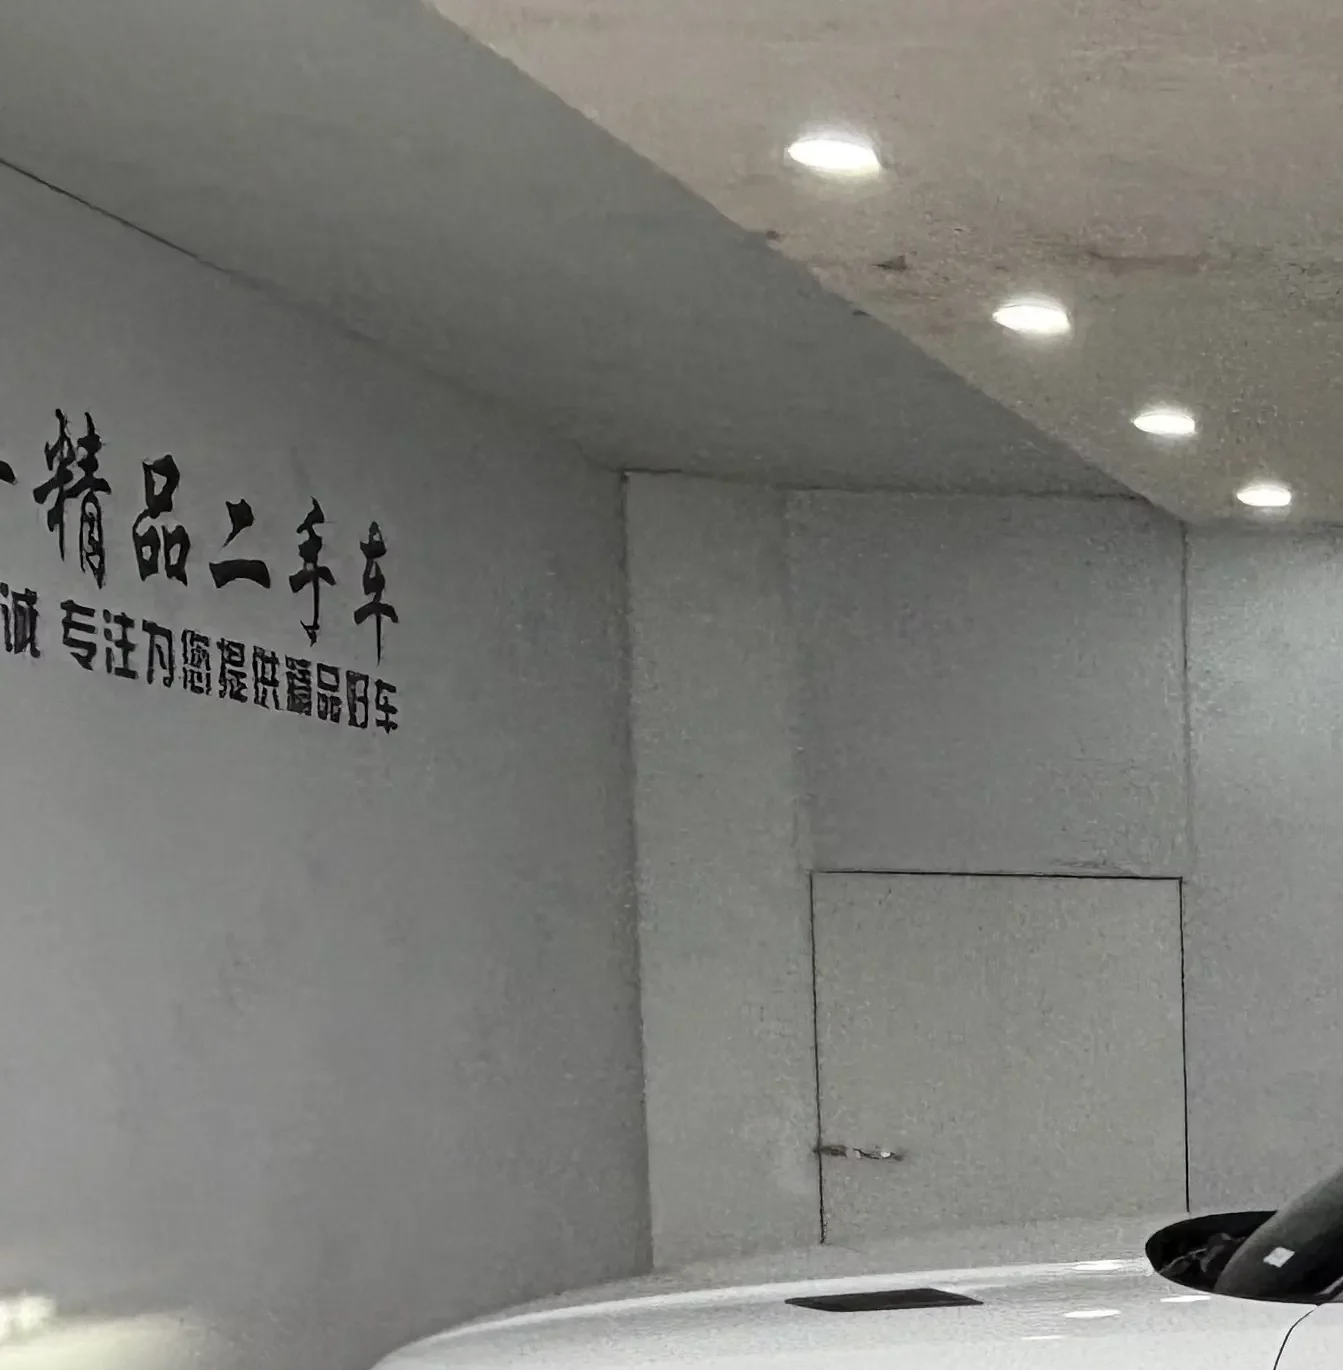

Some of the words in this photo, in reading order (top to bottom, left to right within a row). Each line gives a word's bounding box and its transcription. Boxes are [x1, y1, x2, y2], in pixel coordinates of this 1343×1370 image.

[0, 409, 399, 665] 精品二手车
